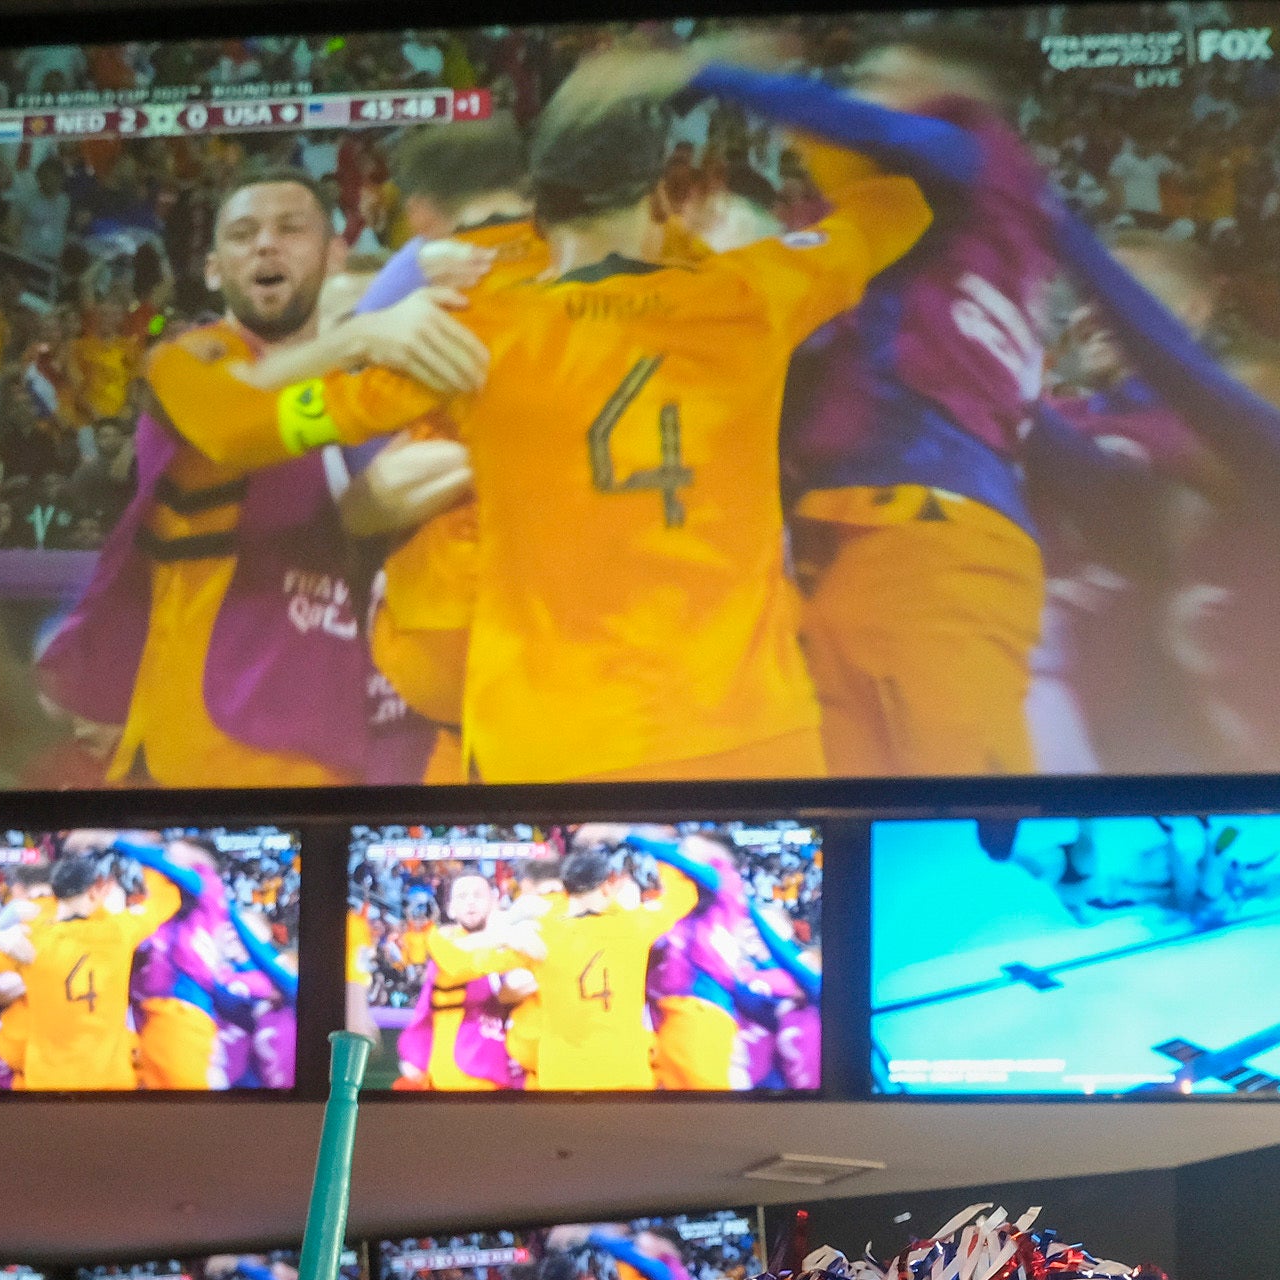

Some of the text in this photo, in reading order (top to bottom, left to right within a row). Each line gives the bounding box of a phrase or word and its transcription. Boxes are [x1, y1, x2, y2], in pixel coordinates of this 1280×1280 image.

[1197, 27, 1274, 63] FOX
[1134, 68, 1182, 89] LIVE
[54, 114, 106, 133] NED
[118, 106, 138, 133] 2
[186, 103, 209, 130] 0
[223, 104, 273, 127] USA
[586, 351, 696, 528] 4
[64, 953, 98, 1013] 4
[578, 948, 612, 1012] 4
